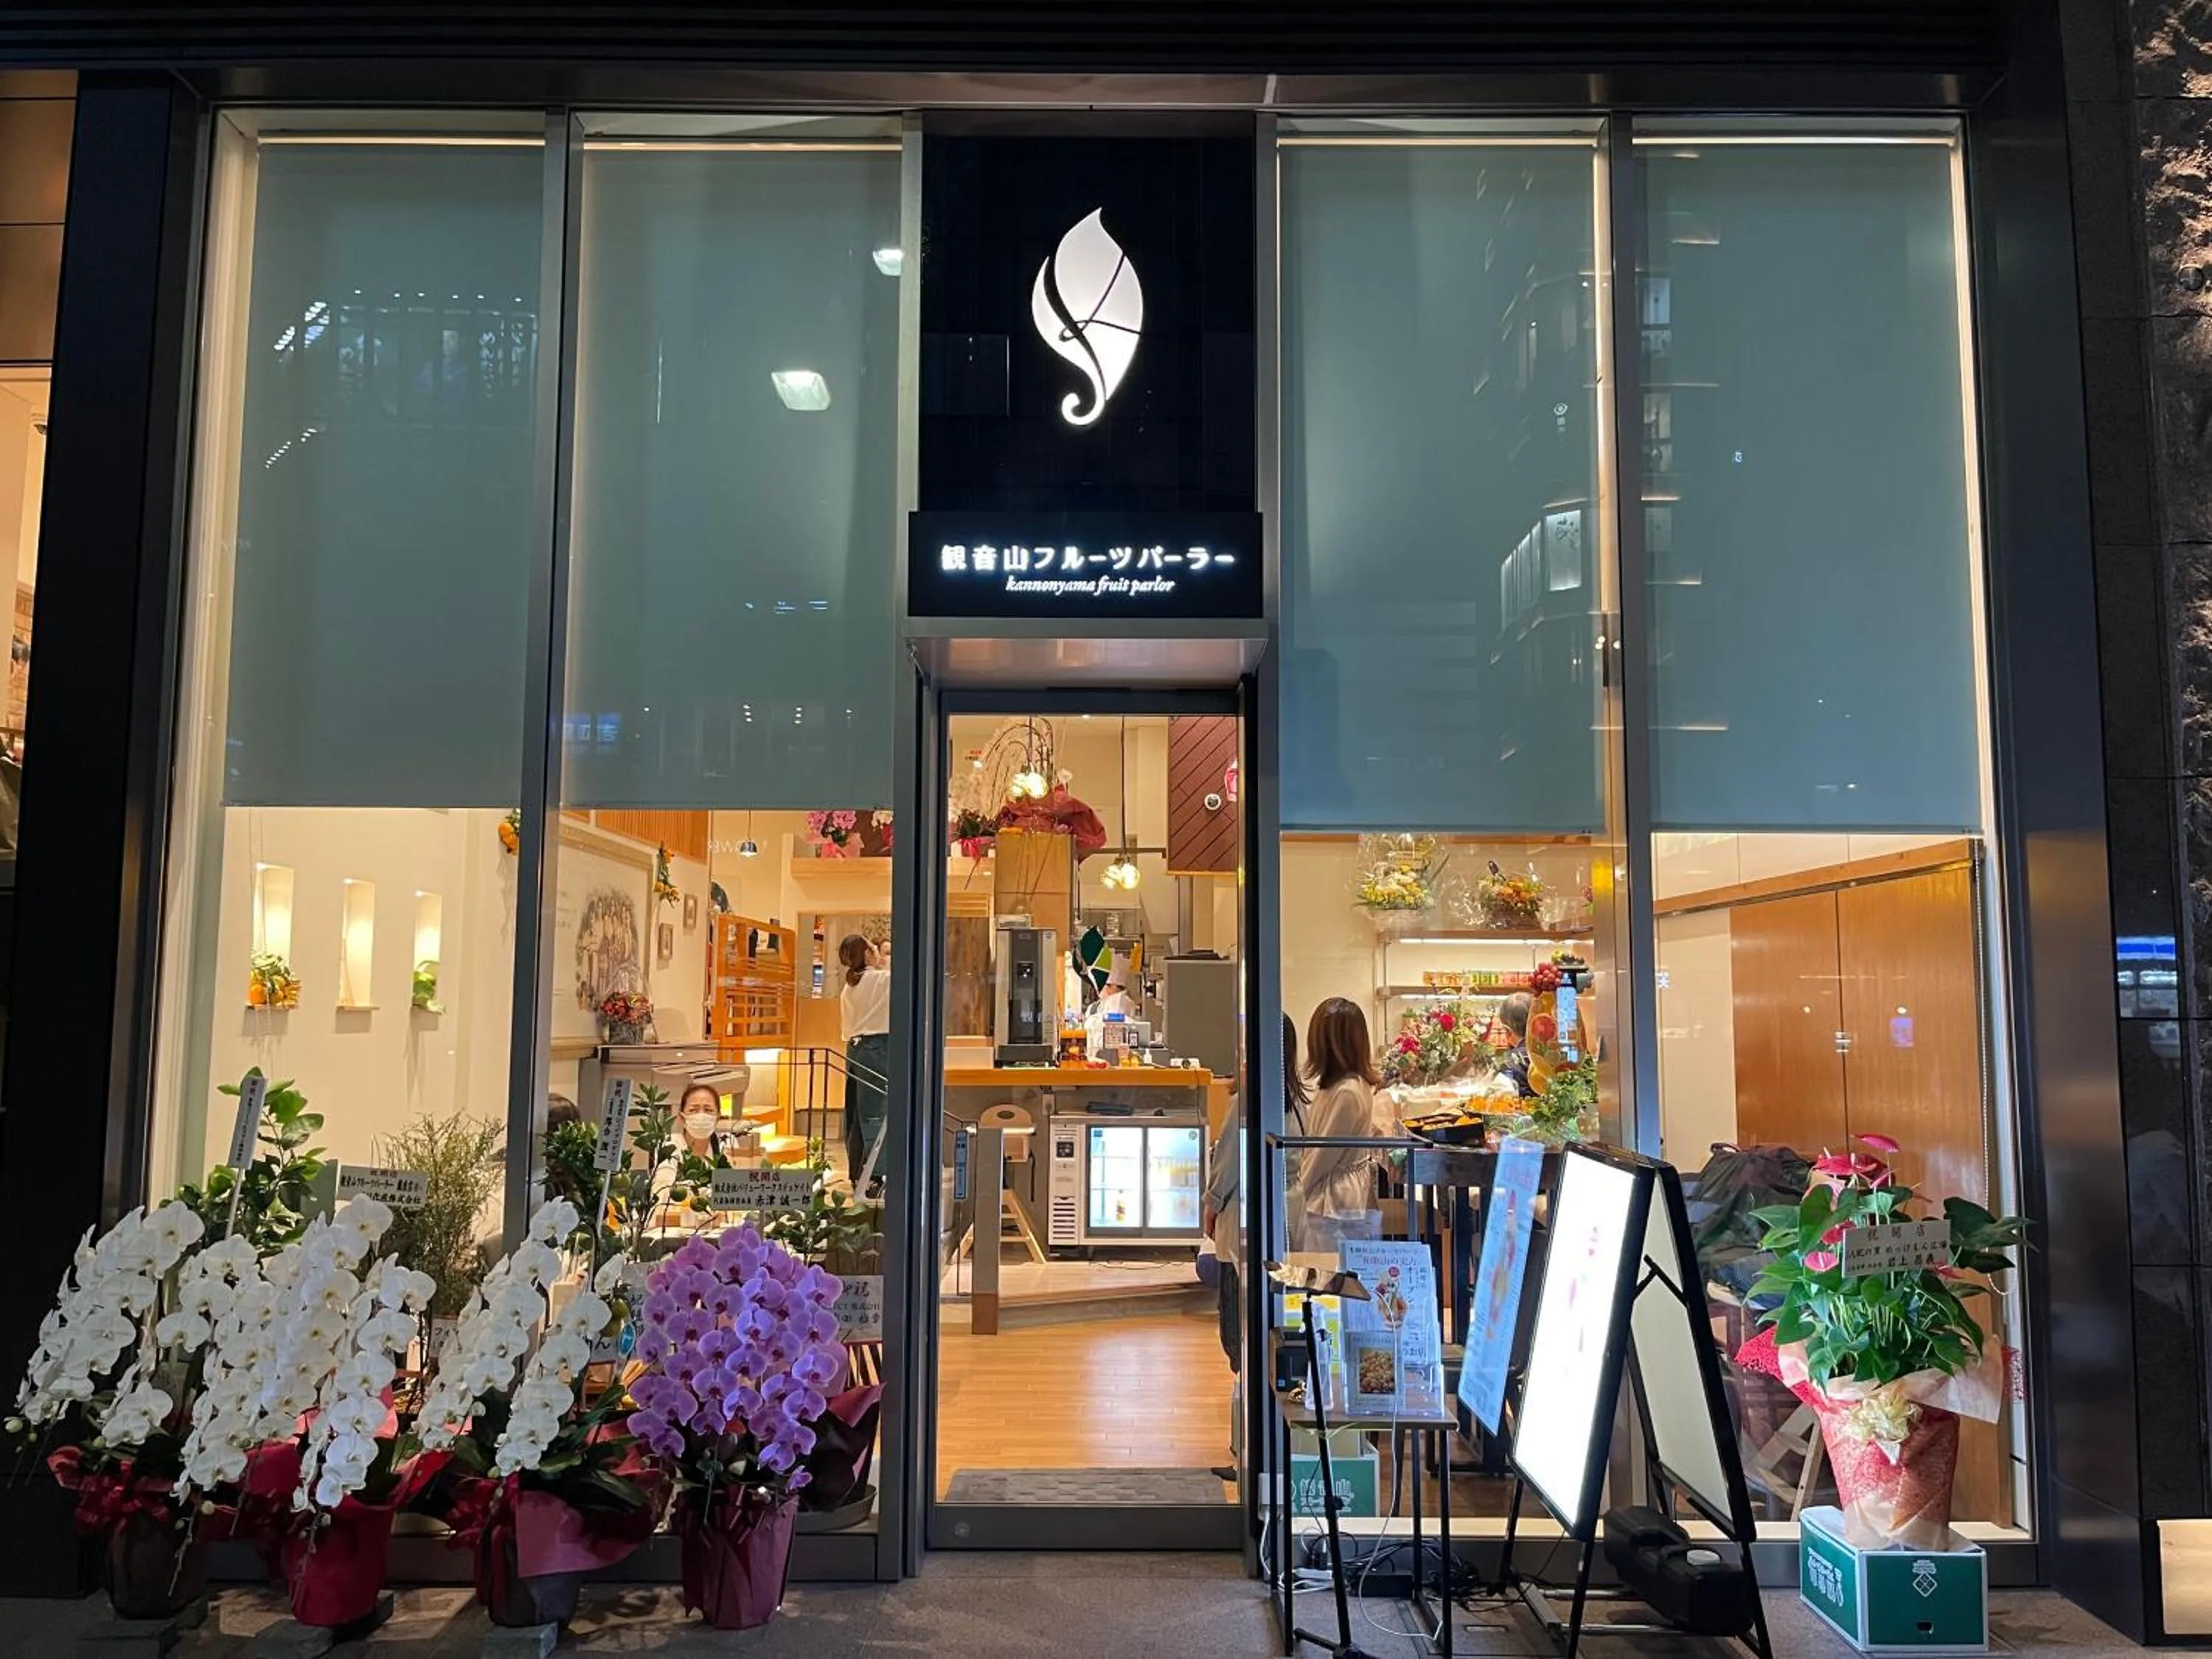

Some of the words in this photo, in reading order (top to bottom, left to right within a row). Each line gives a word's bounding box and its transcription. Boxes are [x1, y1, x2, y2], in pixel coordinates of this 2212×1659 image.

[941, 544, 1236, 571] 観音山フルーツパーラー
[1006, 576, 1095, 596] kannonyama
[1096, 576, 1132, 594] fruit
[1131, 577, 1176, 597] parlor
